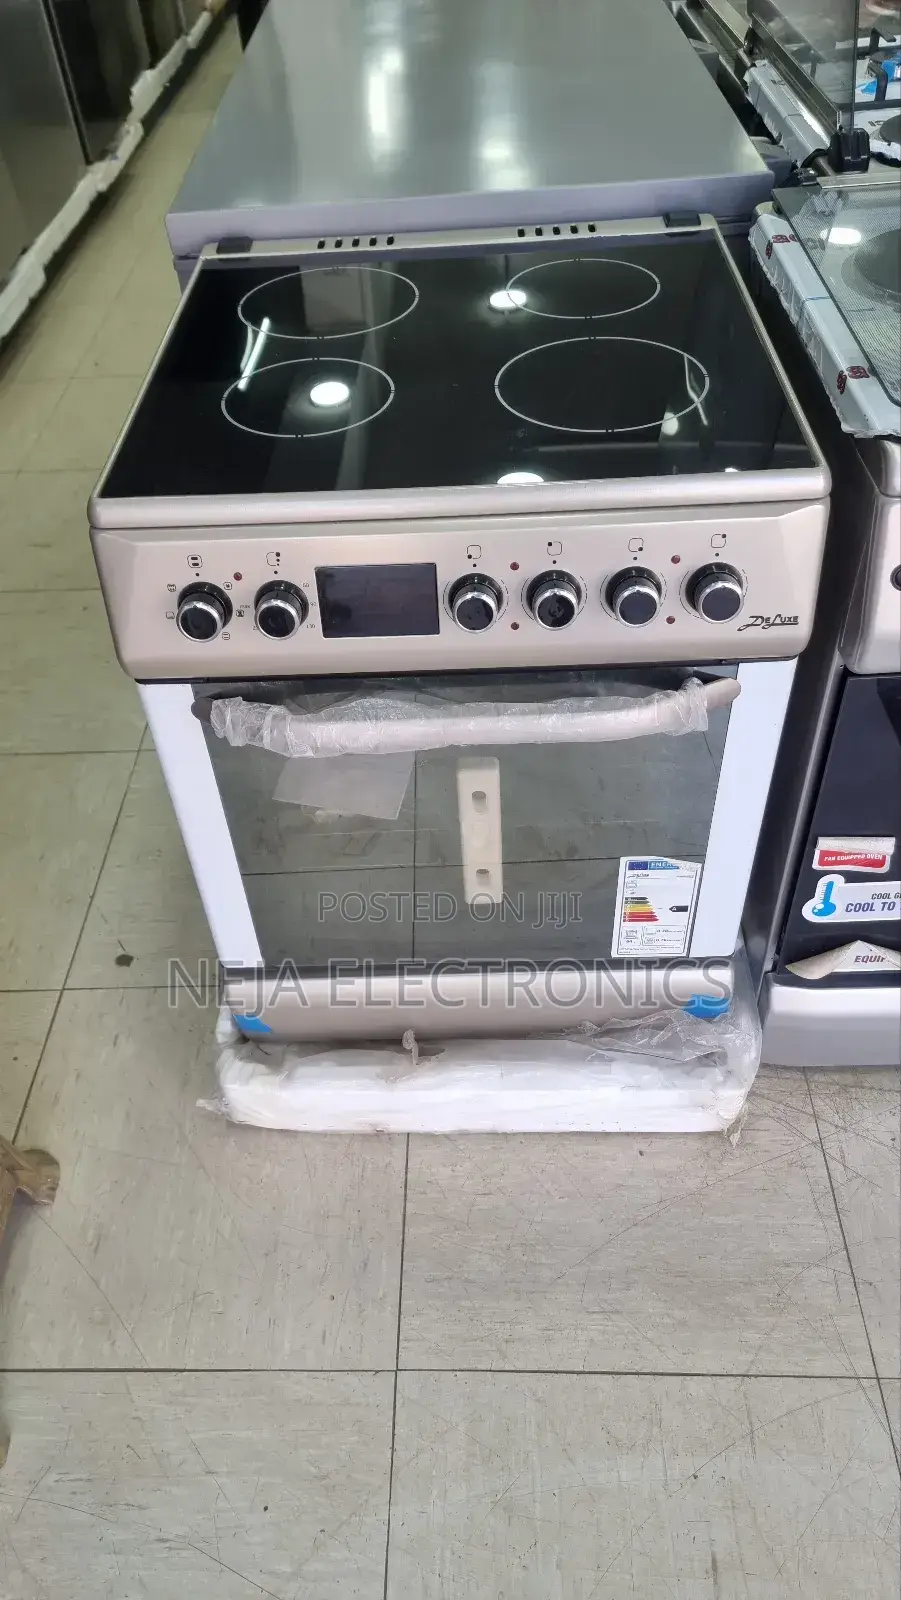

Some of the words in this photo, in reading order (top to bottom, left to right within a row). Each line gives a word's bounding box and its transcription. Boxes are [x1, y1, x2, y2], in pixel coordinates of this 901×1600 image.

[866, 853, 883, 861] OVEN
[871, 892, 891, 900] COOL
[845, 902, 875, 913] COOL
[880, 901, 896, 912] TO
